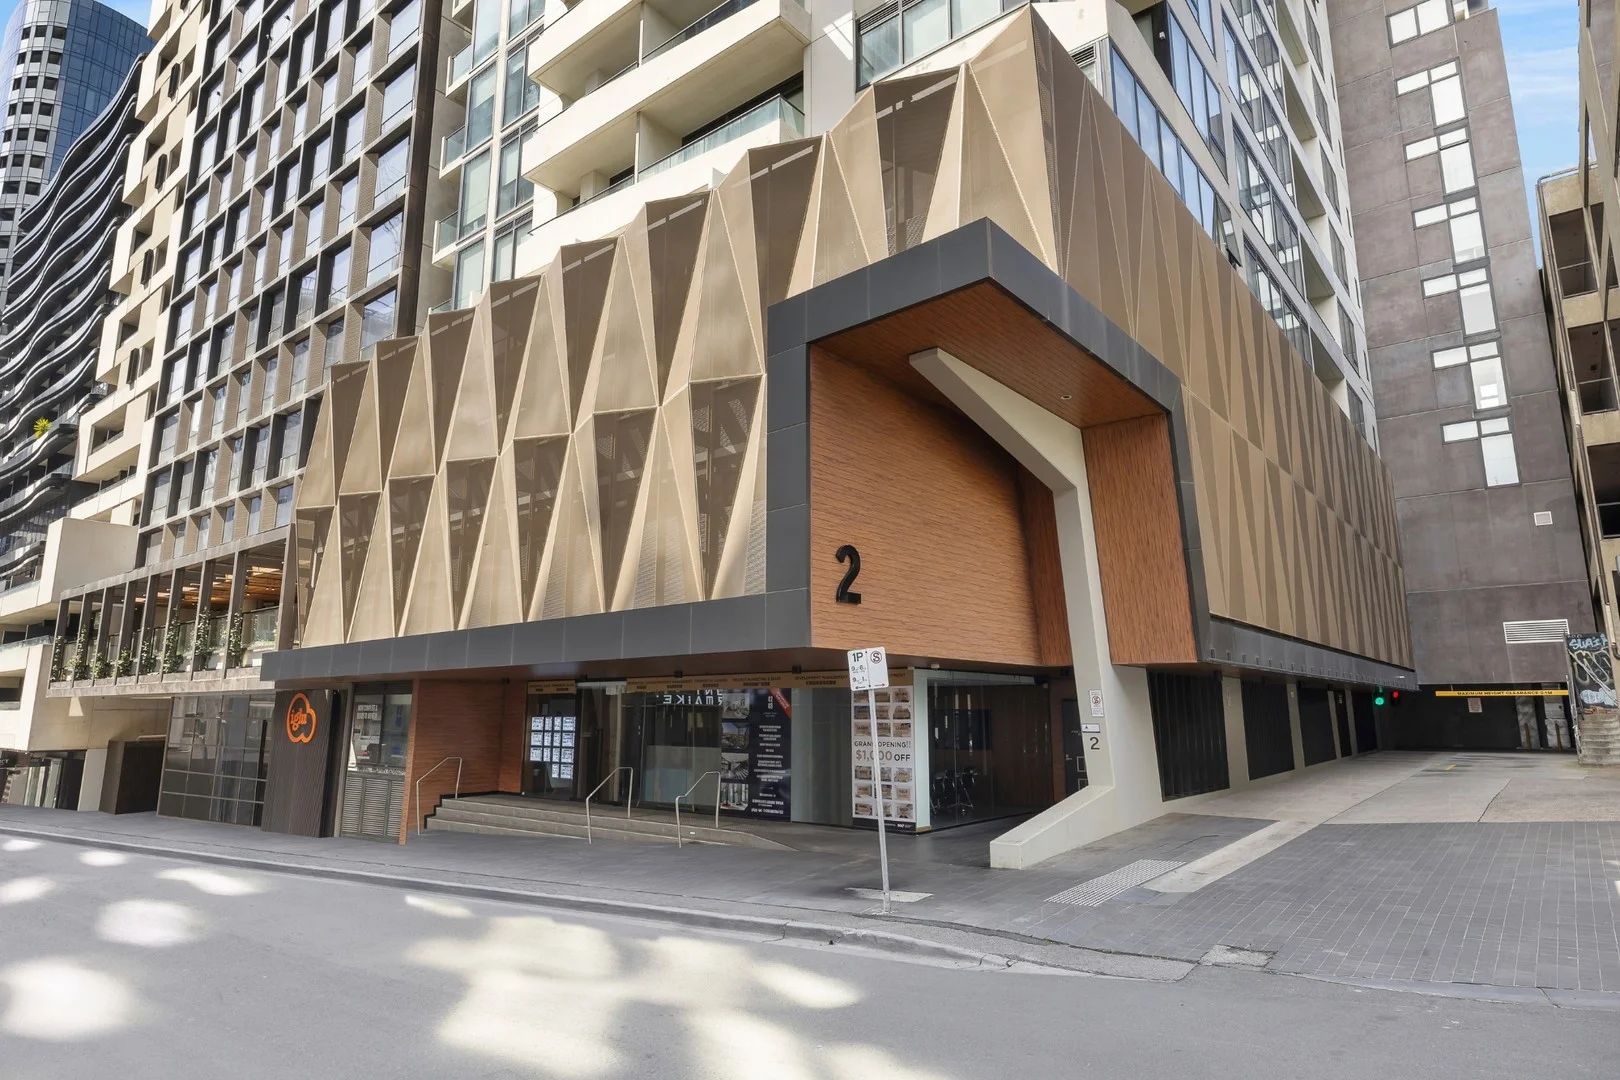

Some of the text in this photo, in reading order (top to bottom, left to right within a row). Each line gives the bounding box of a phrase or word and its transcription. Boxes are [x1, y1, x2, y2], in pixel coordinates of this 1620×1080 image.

[835, 544, 861, 604] 2
[852, 652, 863, 662] 1P
[1089, 736, 1100, 750] 2
